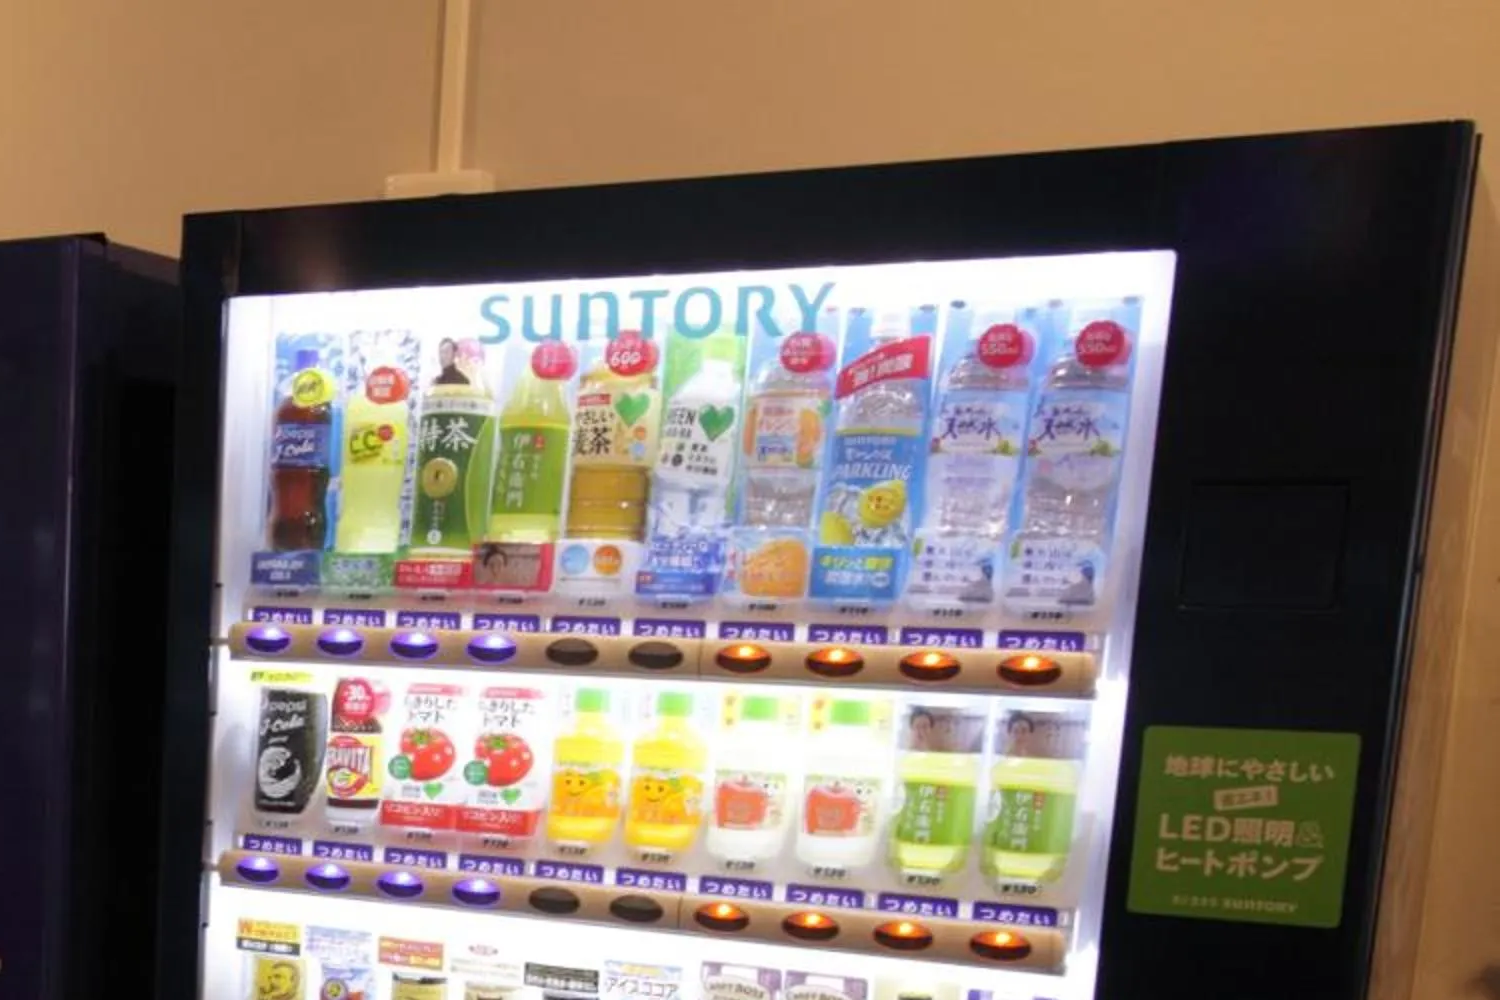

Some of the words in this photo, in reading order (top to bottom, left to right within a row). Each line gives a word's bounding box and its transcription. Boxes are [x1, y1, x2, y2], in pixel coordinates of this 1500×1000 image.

[258, 611, 307, 622] つめたい
[329, 614, 380, 625] つめたい
[403, 616, 455, 628] つめたい
[479, 618, 535, 630] つめたい
[557, 621, 615, 633] つめたい
[640, 623, 700, 635] つめたい
[725, 627, 788, 639] つめたい
[814, 629, 882, 643] つめたい
[906, 632, 978, 646] つめたい
[1003, 635, 1079, 650] つめたい
[409, 710, 444, 724] トマト
[484, 714, 520, 728] トマト
[1164, 753, 1336, 783] 地球にやさしい
[249, 840, 297, 855] つめたい
[319, 846, 367, 860] つめたい
[390, 853, 441, 868] つめたい
[464, 860, 518, 875] つめたい
[541, 868, 598, 883] つめたい
[621, 875, 680, 890] つめたい
[705, 883, 767, 899] つめたい
[792, 892, 858, 908] つめたい
[883, 900, 953, 917] つめたい
[978, 907, 1052, 927] つめたい
